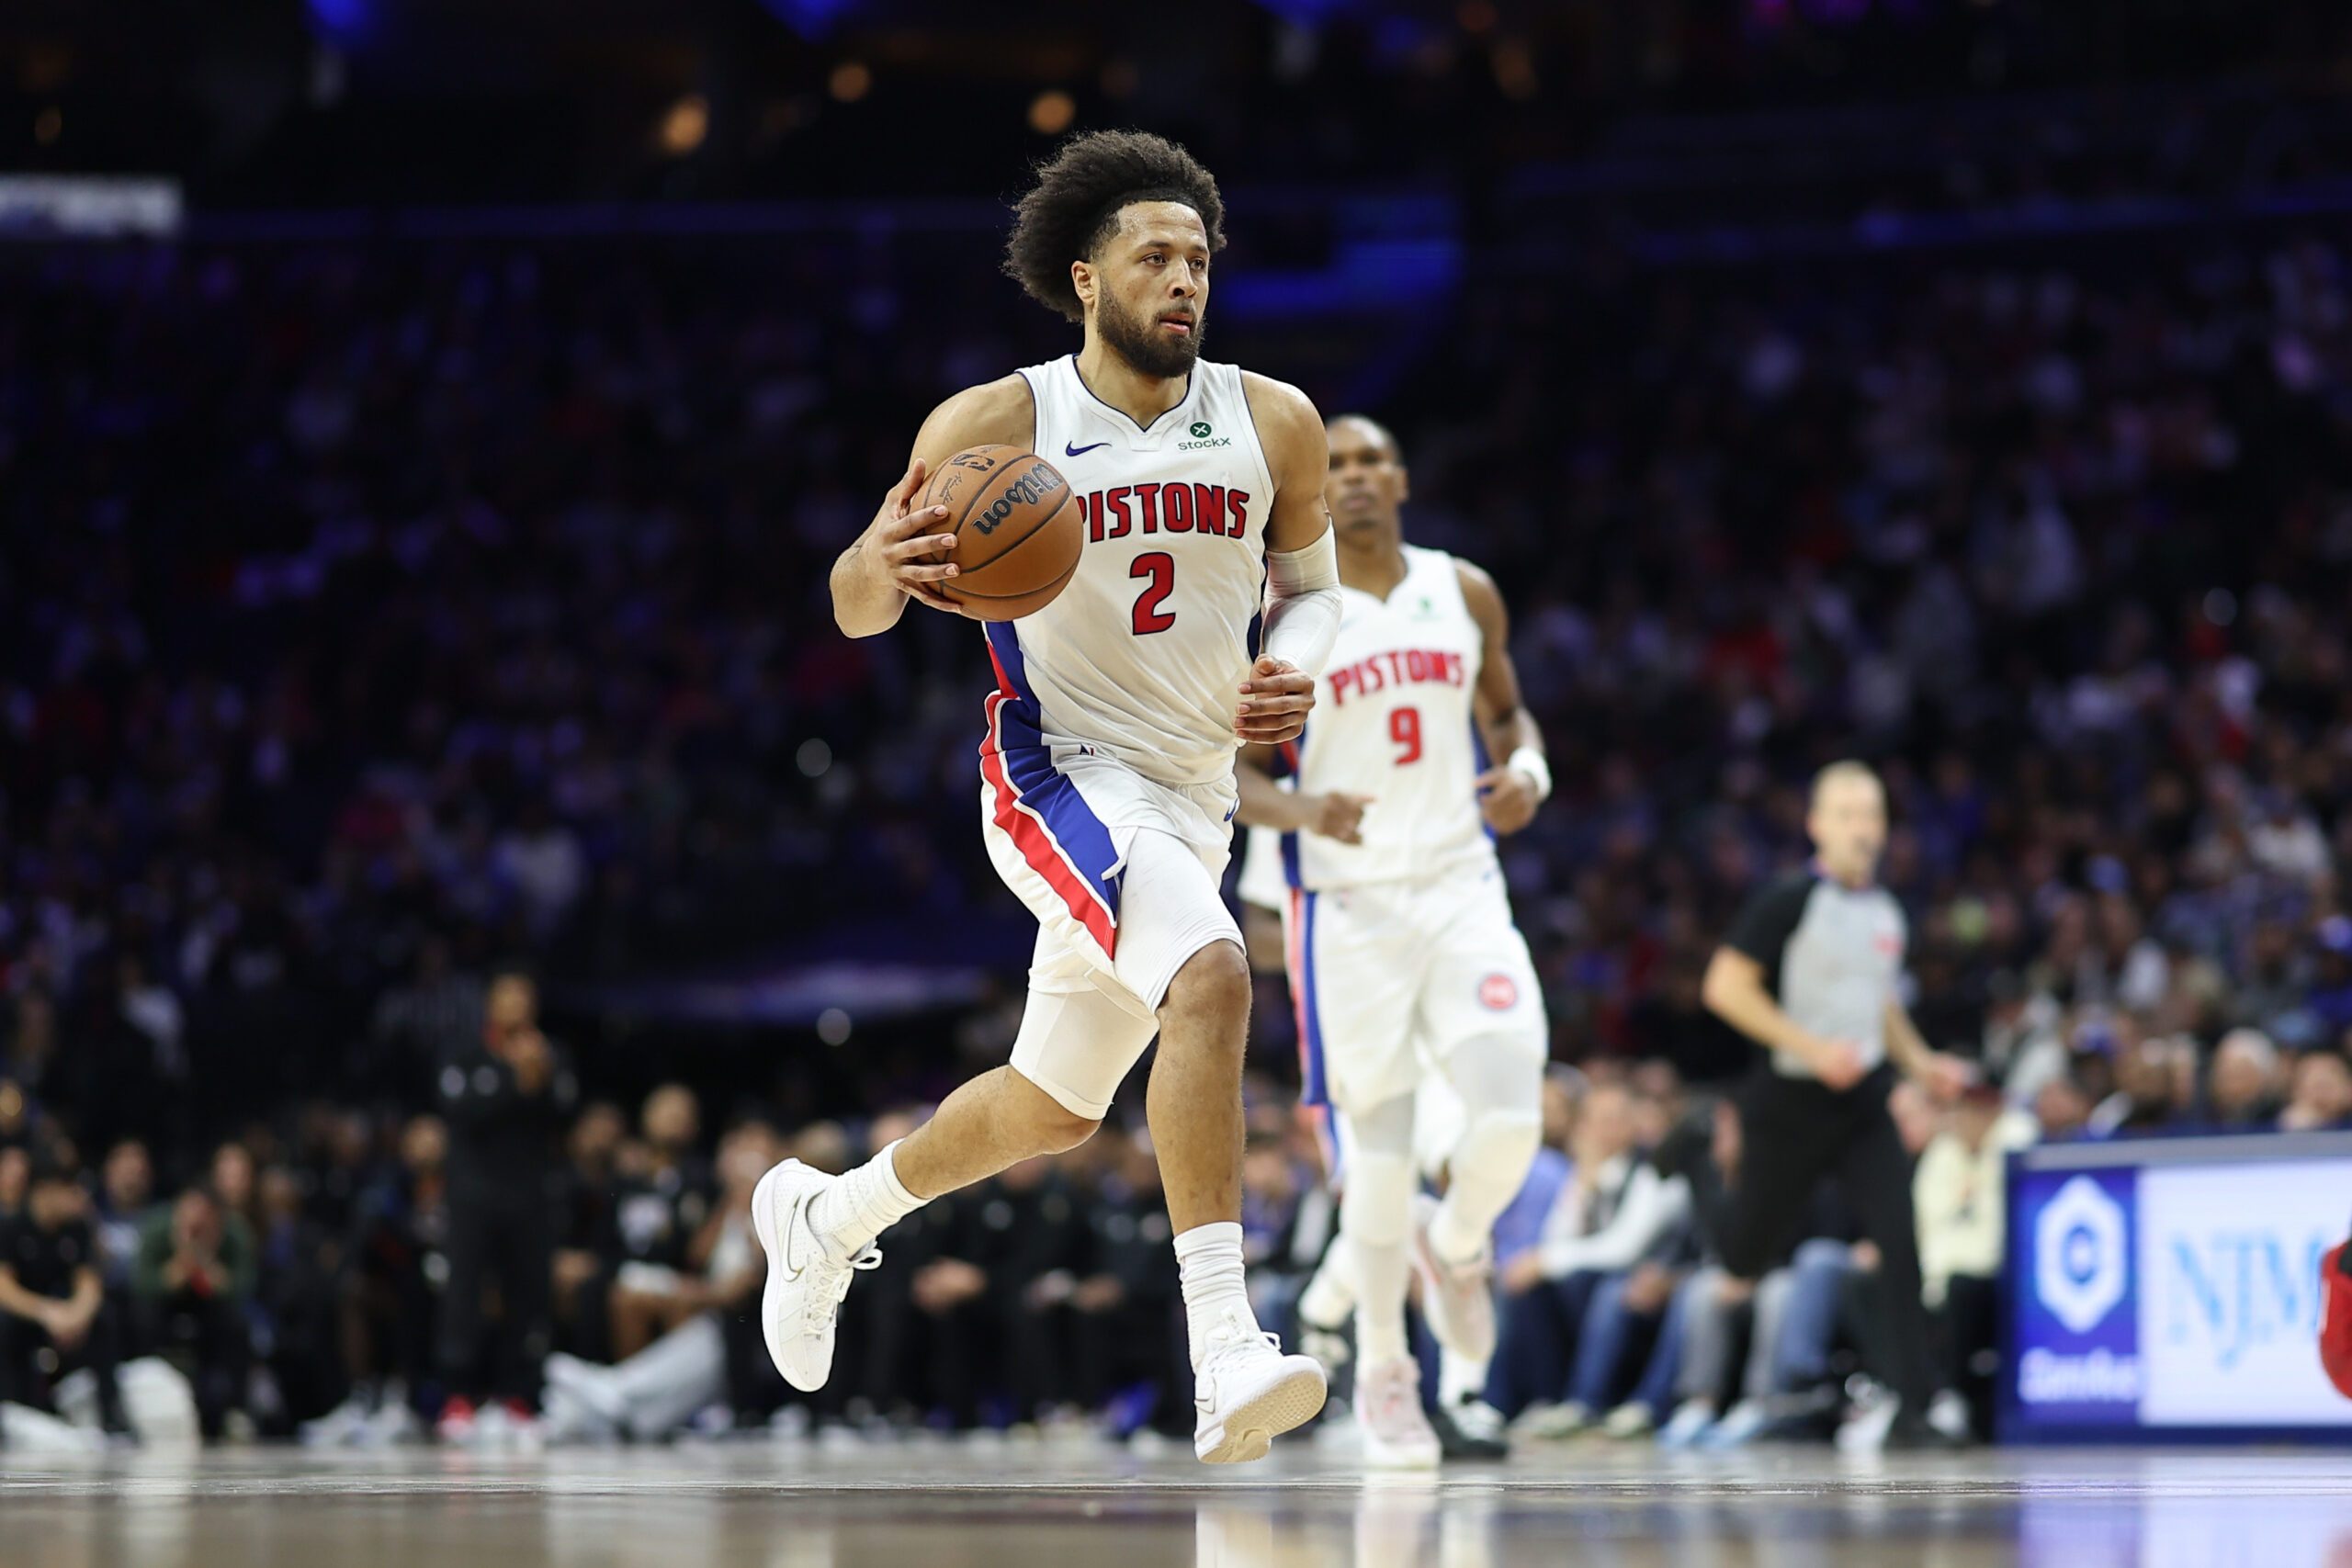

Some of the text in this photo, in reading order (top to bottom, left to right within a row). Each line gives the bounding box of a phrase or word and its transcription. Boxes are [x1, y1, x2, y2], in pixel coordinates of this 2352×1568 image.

[972, 463, 1063, 536] Wilson
[1129, 551, 1176, 636] 2
[1329, 649, 1464, 706] PISTONS
[1389, 706, 1422, 766] 9
